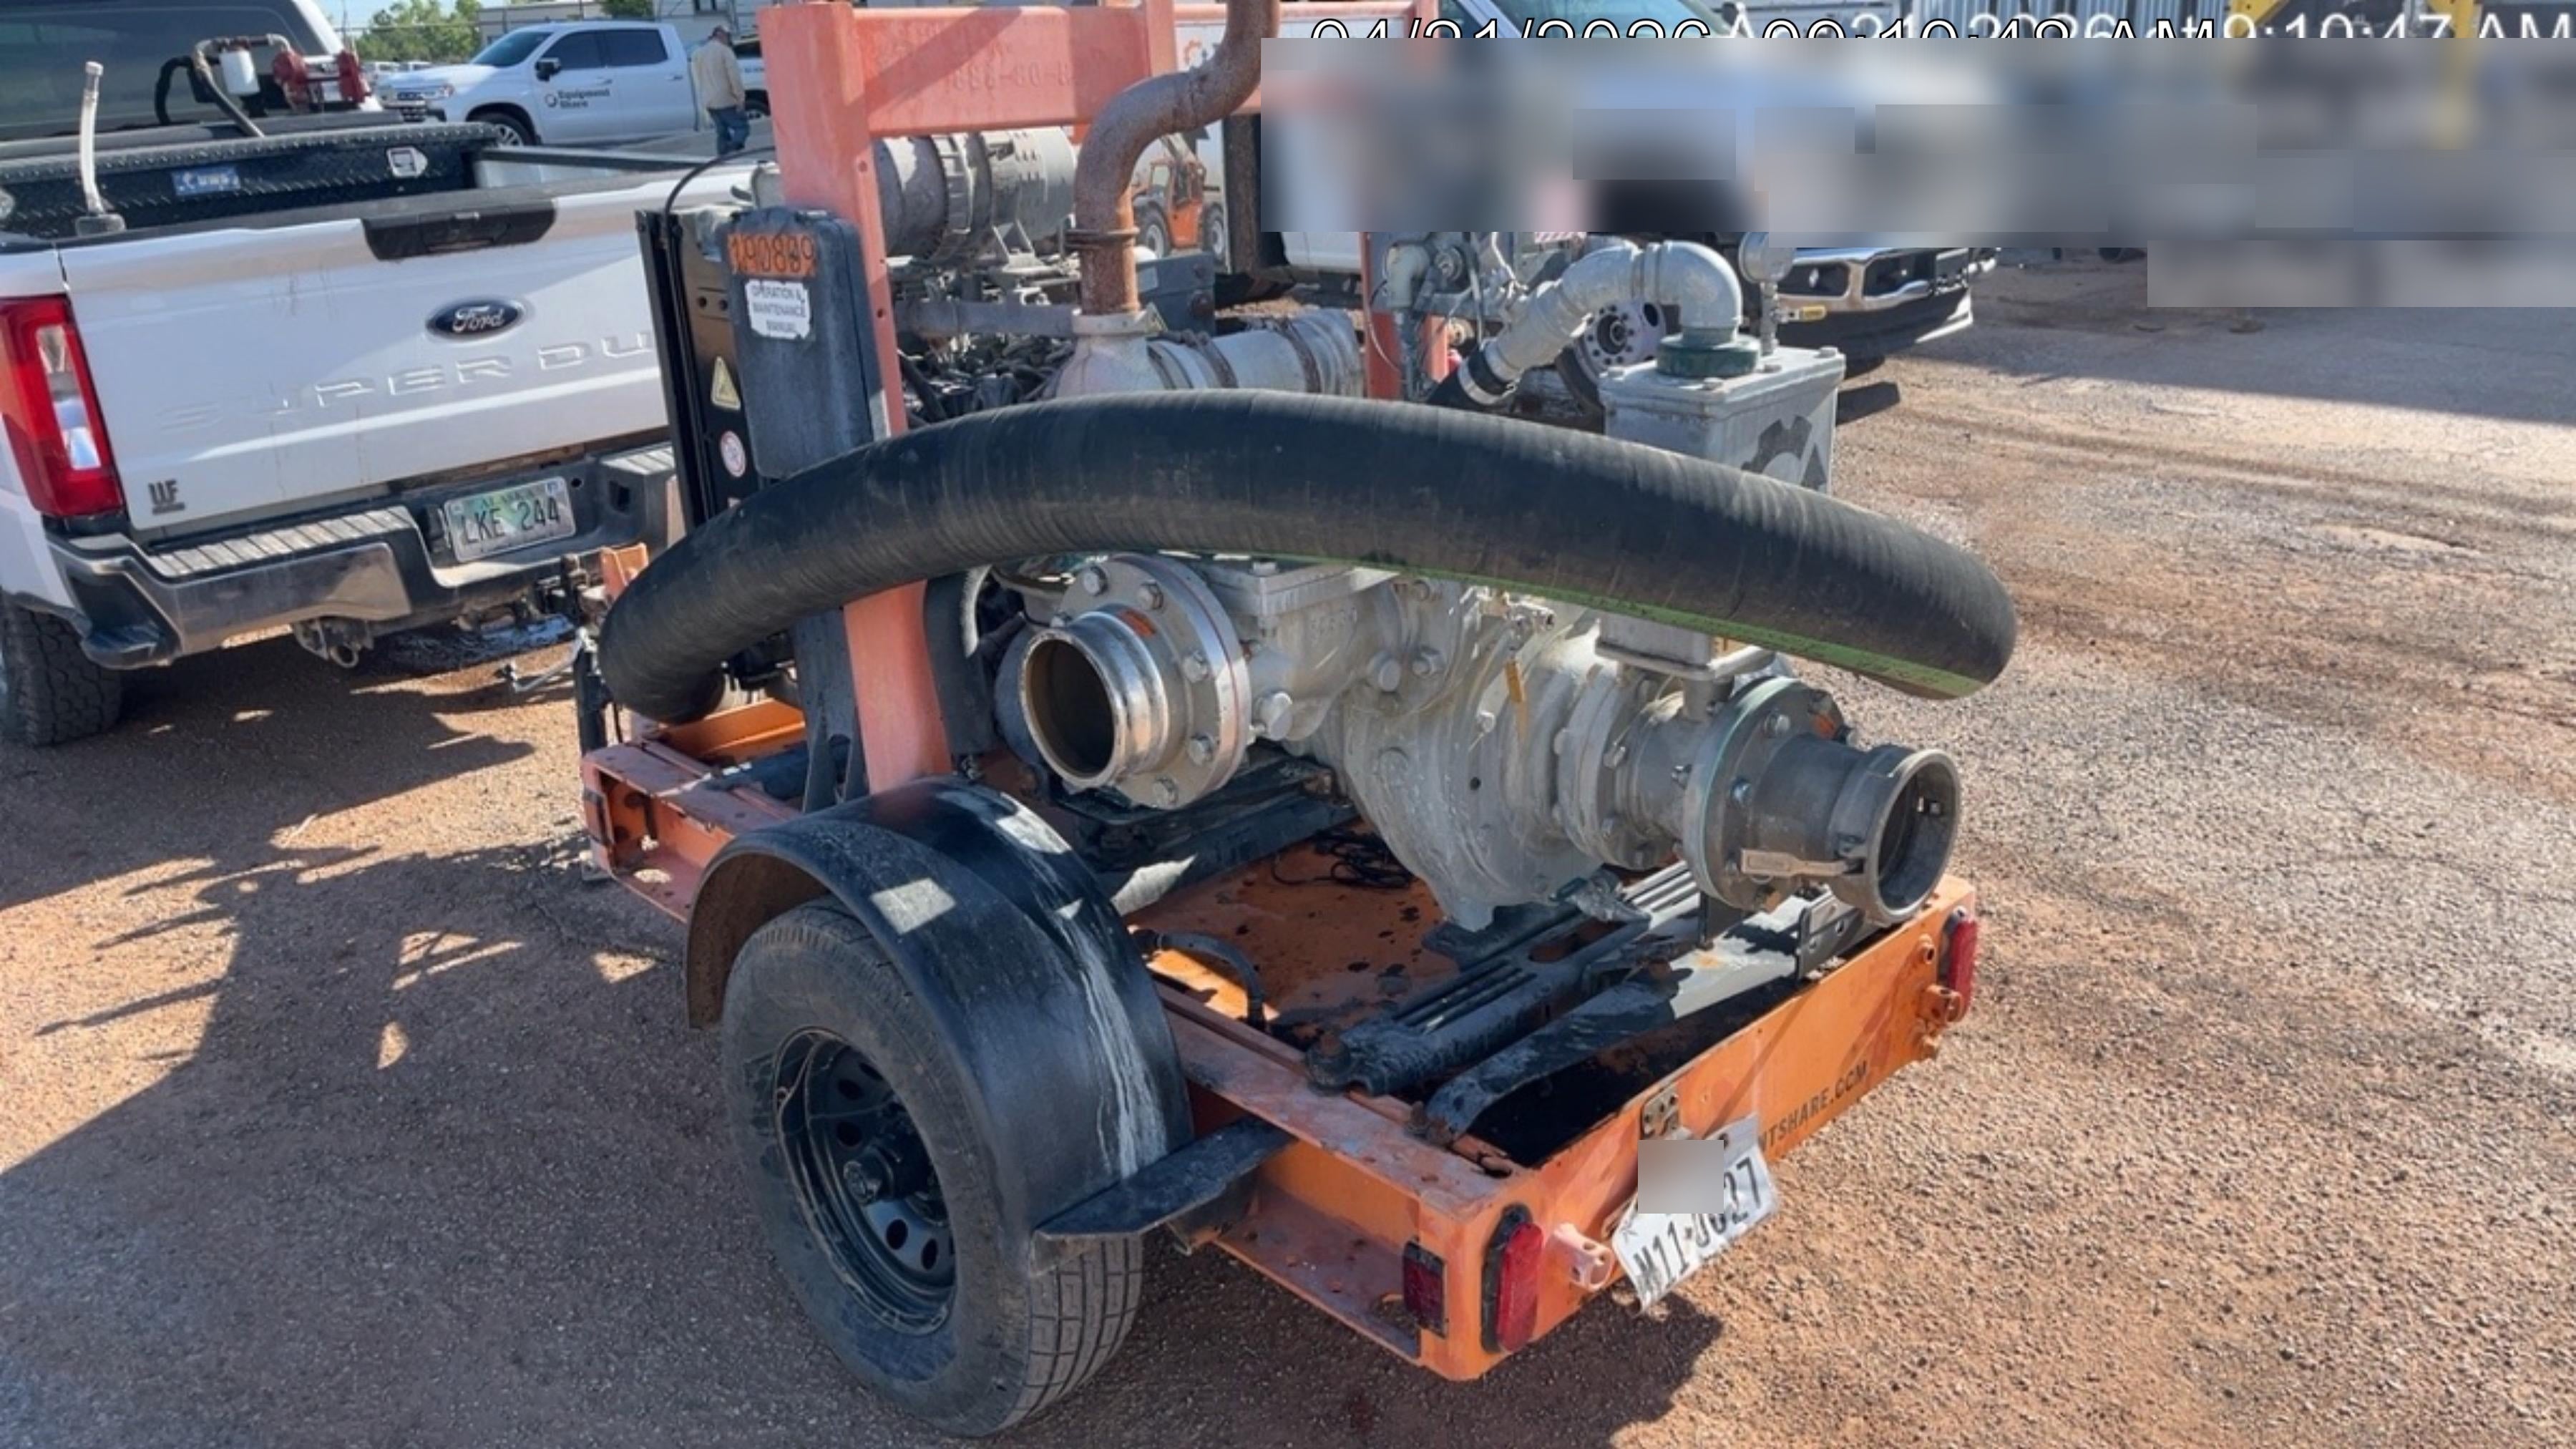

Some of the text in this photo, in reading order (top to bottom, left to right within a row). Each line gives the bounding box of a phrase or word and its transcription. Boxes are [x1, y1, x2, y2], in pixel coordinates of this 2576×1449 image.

[557, 88, 610, 99] Equipment
[751, 285, 794, 298] OPERATION
[753, 303, 806, 317] MAINTENANCE
[452, 305, 504, 332] Ford
[460, 504, 505, 545] LKE
[517, 496, 561, 531] 244
